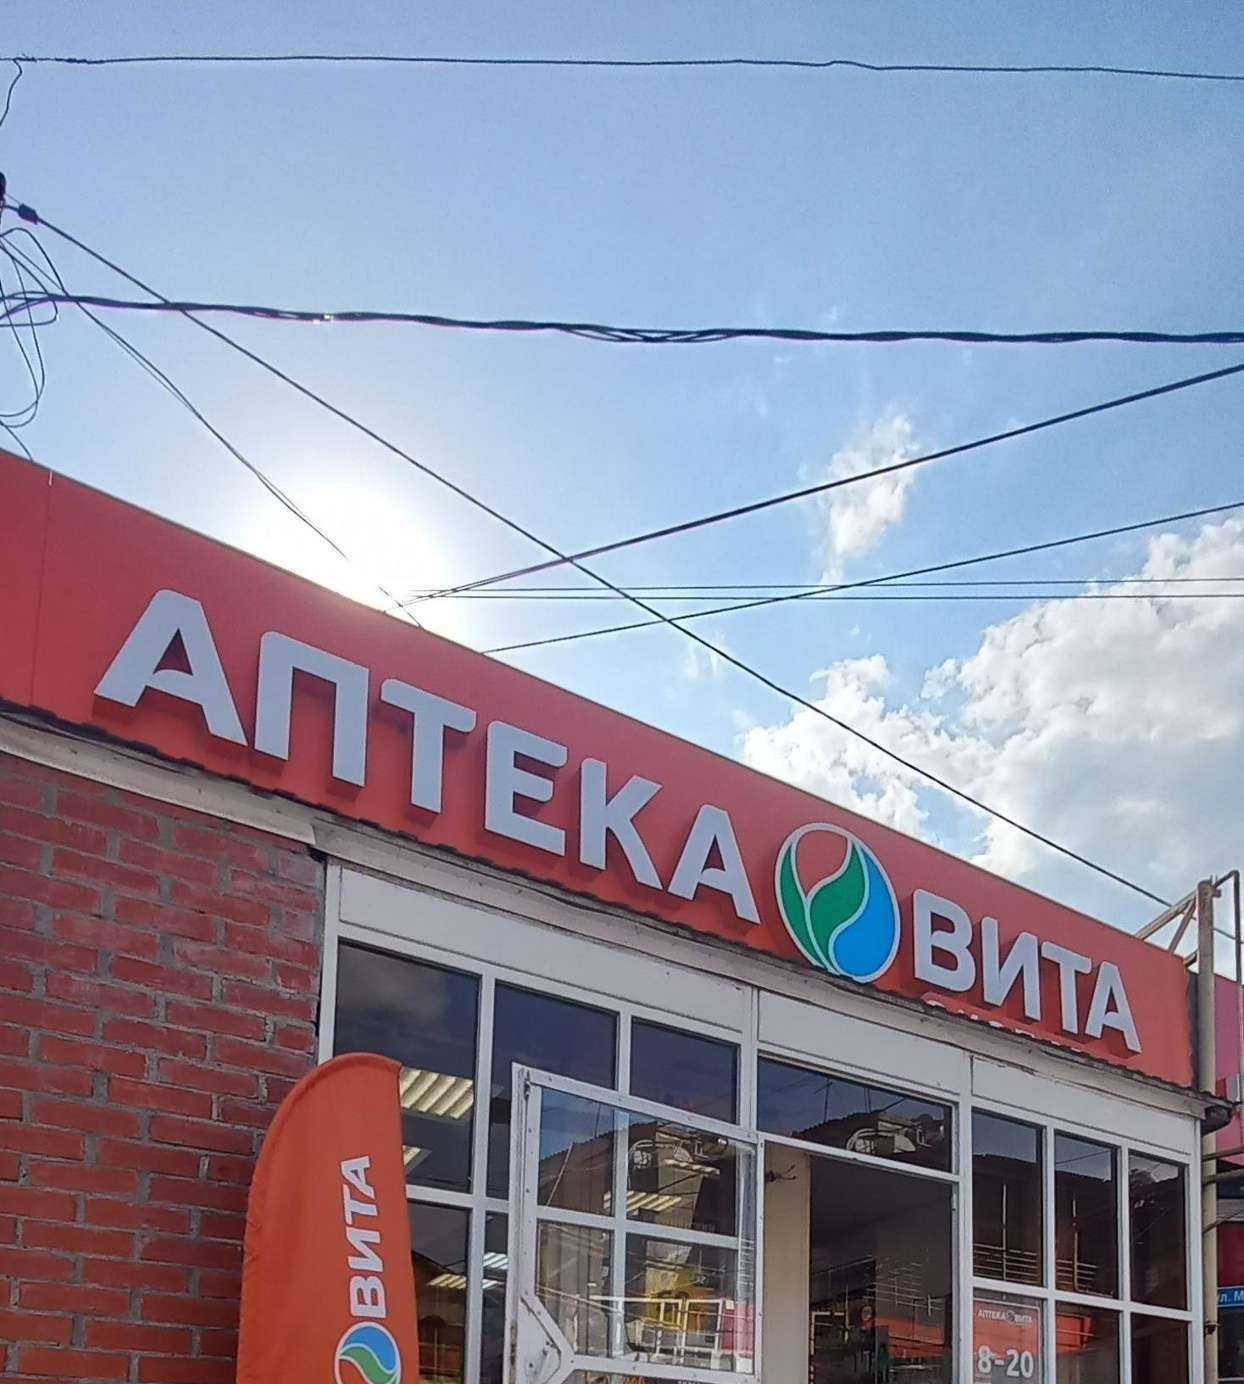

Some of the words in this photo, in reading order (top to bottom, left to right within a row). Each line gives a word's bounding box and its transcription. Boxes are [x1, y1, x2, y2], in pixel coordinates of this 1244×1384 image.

[94, 588, 761, 924] АПТЕКА
[912, 888, 1143, 1054] ВИТА
[340, 1155, 388, 1318] ВИТА
[976, 1309, 1006, 1321] АПТЕКА
